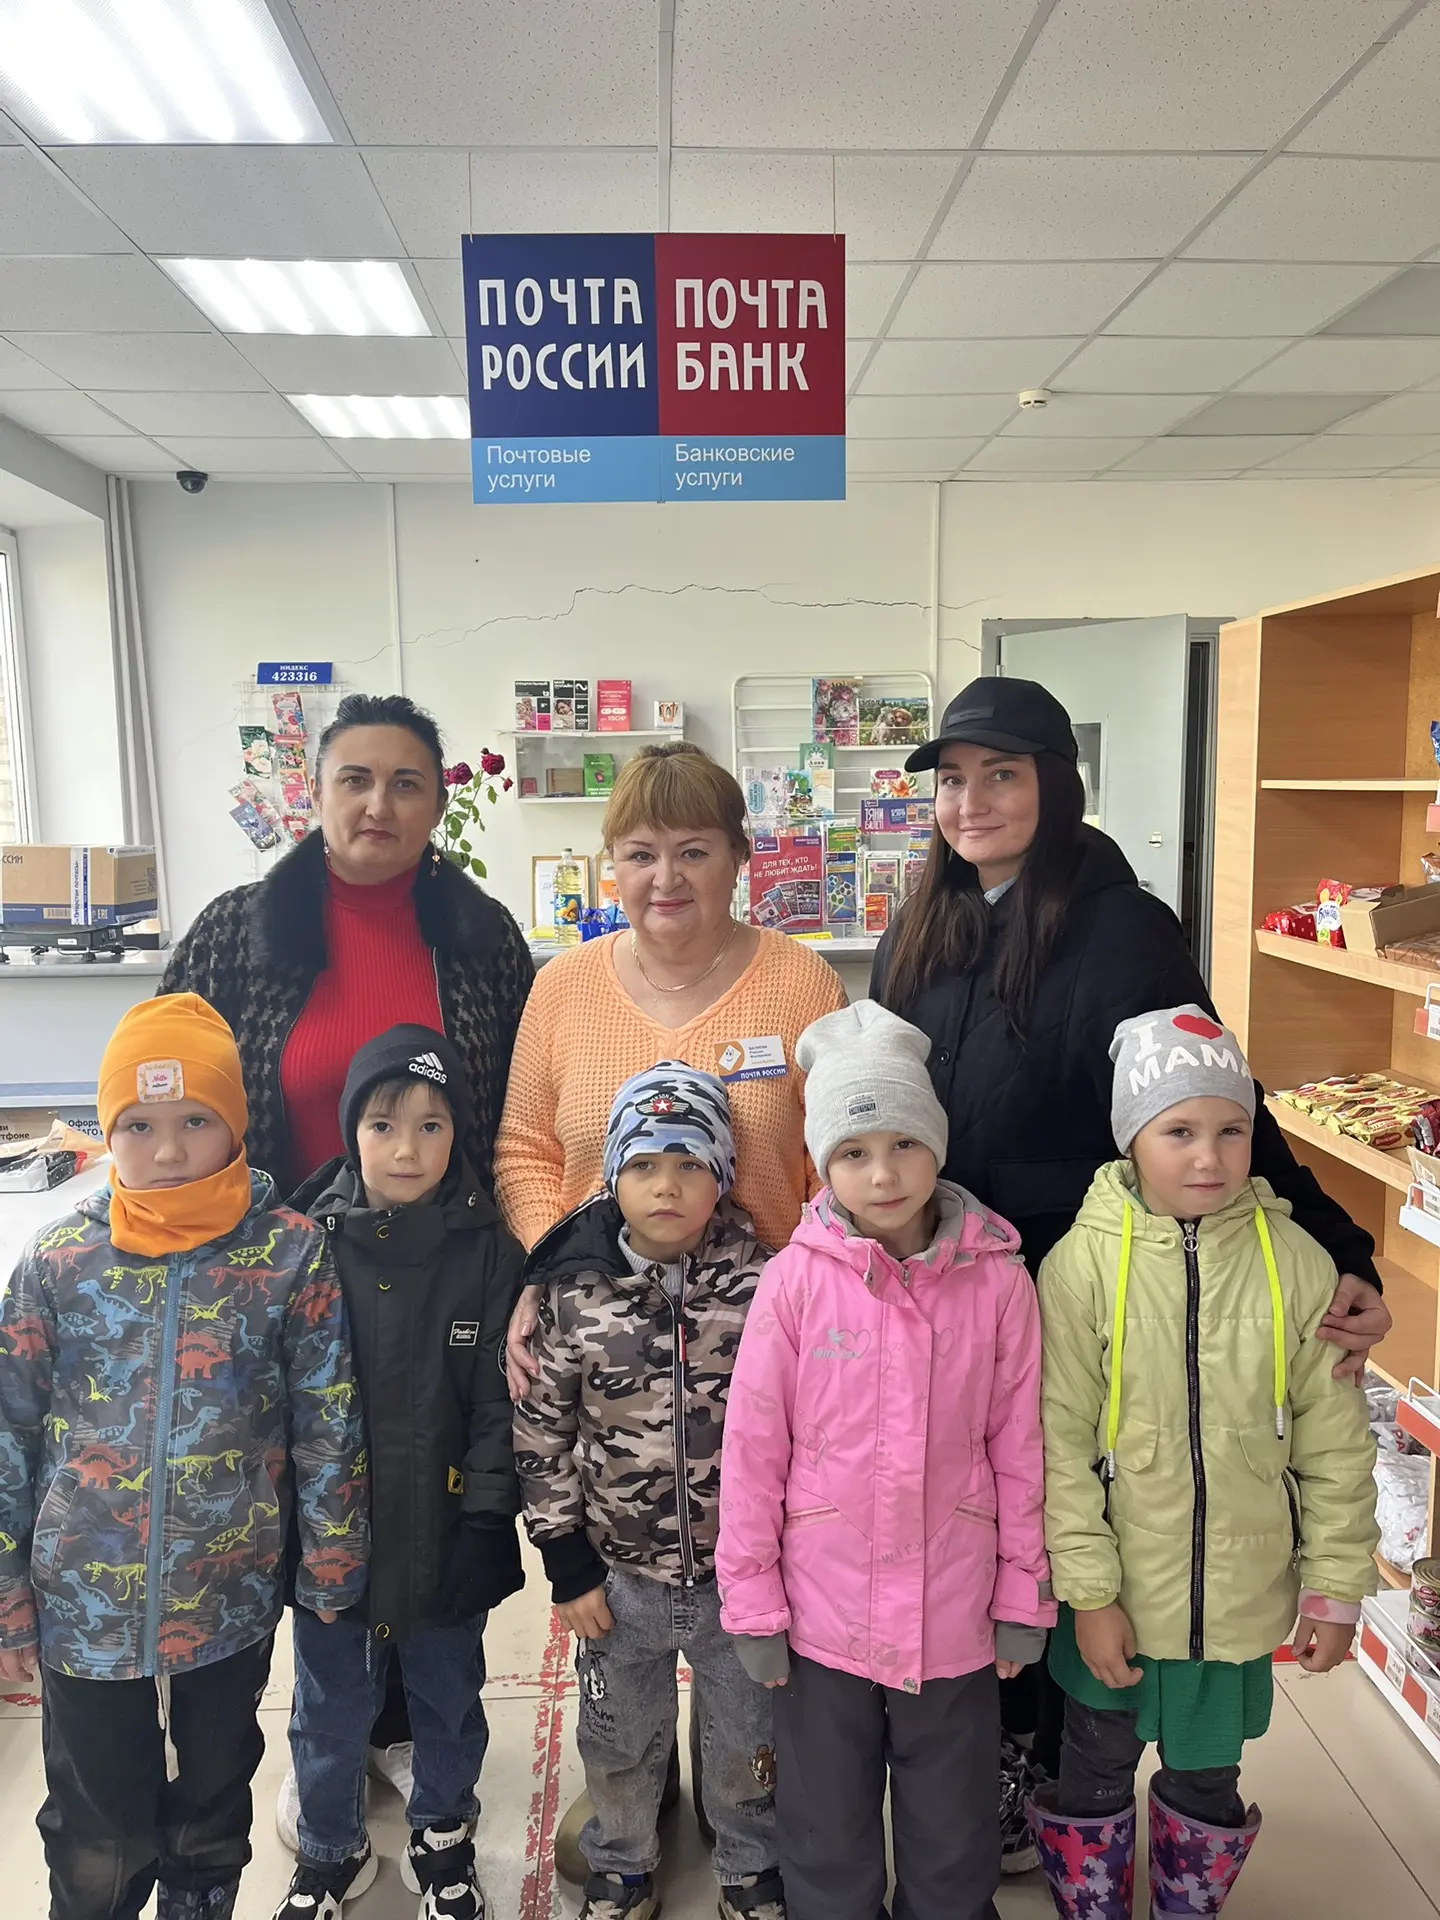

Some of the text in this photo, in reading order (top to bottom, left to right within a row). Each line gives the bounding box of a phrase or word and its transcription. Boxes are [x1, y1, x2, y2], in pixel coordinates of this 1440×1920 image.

[478, 278, 643, 326] ПОЧТА
[675, 278, 828, 329] ПОЧТА
[482, 342, 646, 390] РОССИИ
[677, 342, 809, 391] БАНК
[487, 445, 591, 464] Почтовые
[676, 443, 795, 462] Банковские
[488, 472, 556, 493] услуги
[675, 470, 743, 490] услуги
[272, 671, 317, 682] 423316
[864, 808, 884, 820] ТЯНИ
[753, 871, 764, 879] НЕ
[764, 867, 790, 877] ЛЮБИТ
[791, 864, 818, 874] ЖДАТЬ!
[762, 856, 809, 870] ДЛЯ ТЕХ, КТО
[1131, 1021, 1162, 1062] I
[408, 1062, 448, 1084] adidas
[740, 1067, 786, 1079] ПОЧТА РОССИИ
